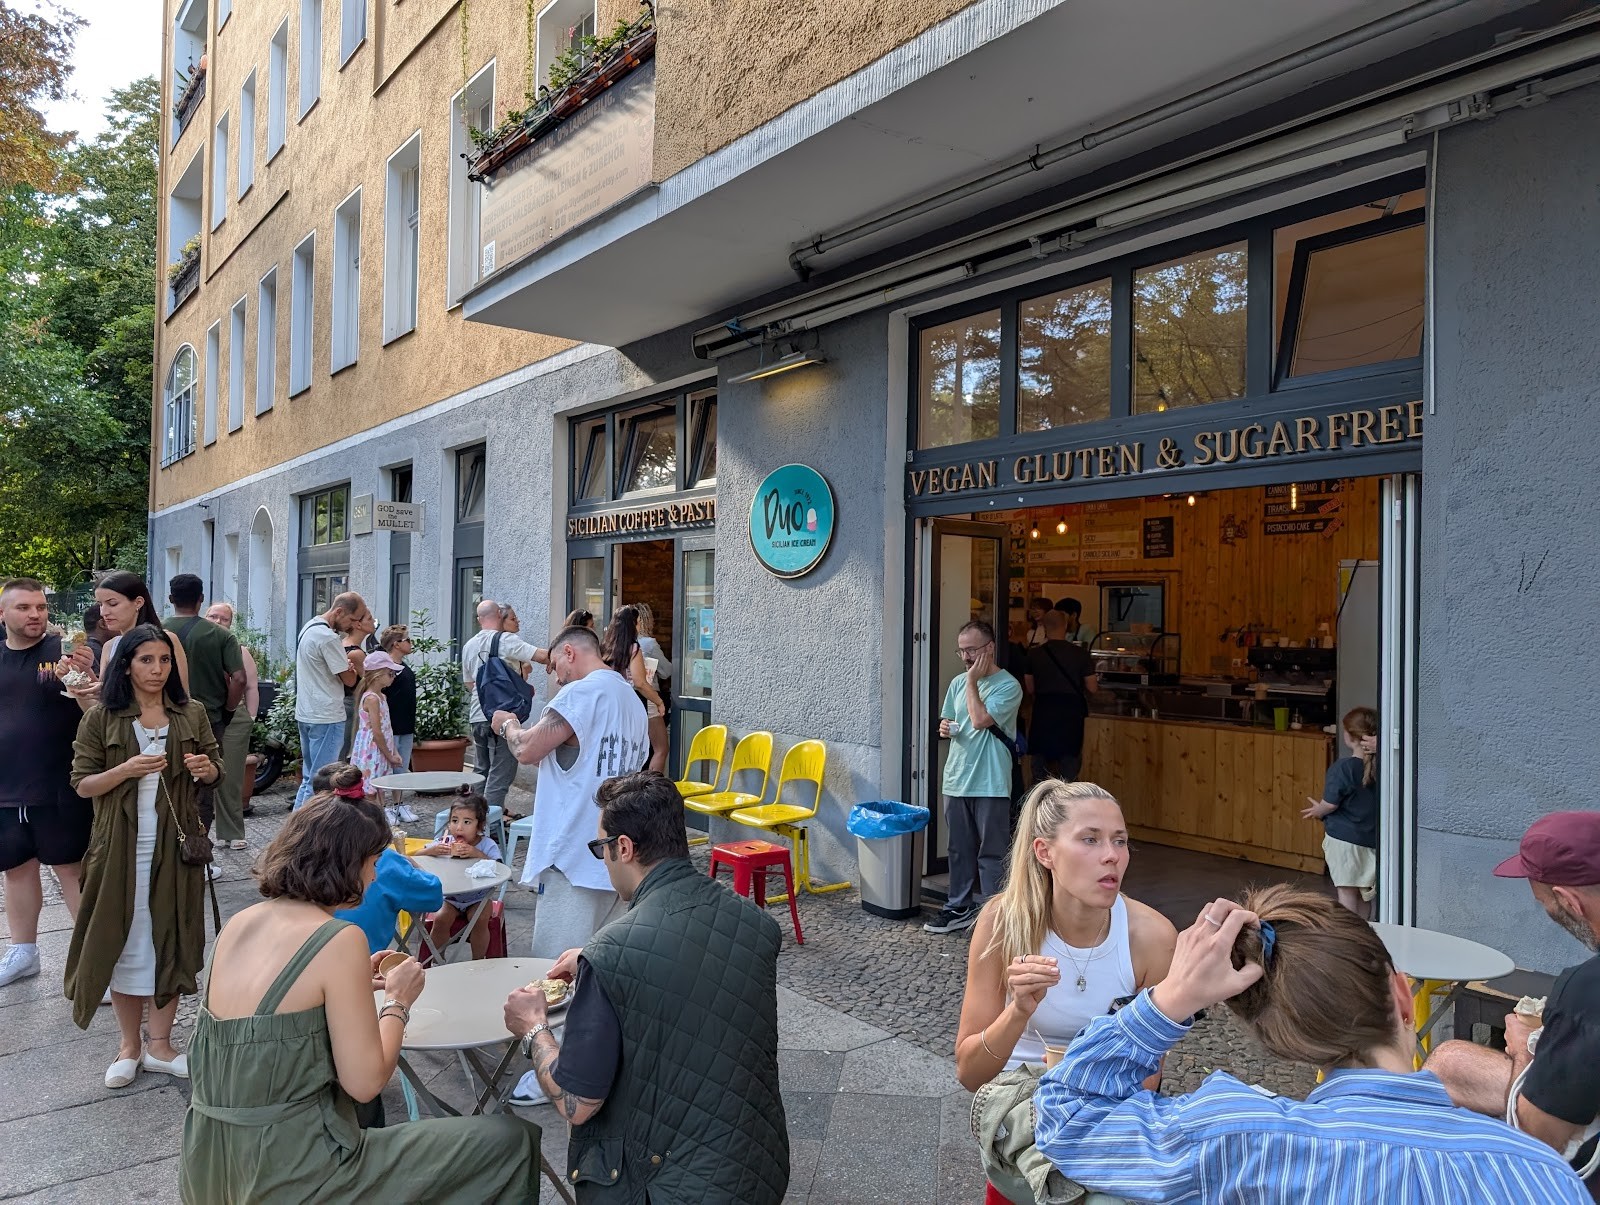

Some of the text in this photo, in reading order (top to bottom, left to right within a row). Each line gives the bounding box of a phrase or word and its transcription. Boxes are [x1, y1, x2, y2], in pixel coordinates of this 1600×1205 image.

[530, 136, 556, 163] BERLIN.
[909, 460, 997, 496] VEGAN
[1013, 441, 1143, 484] GLUTEN
[1156, 437, 1185, 469] &
[377, 504, 395, 512] GOD
[377, 519, 415, 529] MULLET
[568, 513, 618, 536] SICILIAN
[619, 508, 666, 531] COFFEE
[668, 504, 679, 522] &
[1267, 522, 1311, 532] PISTACCHIO CAKE
[771, 538, 816, 548] SICILIAN ICE CREAM
